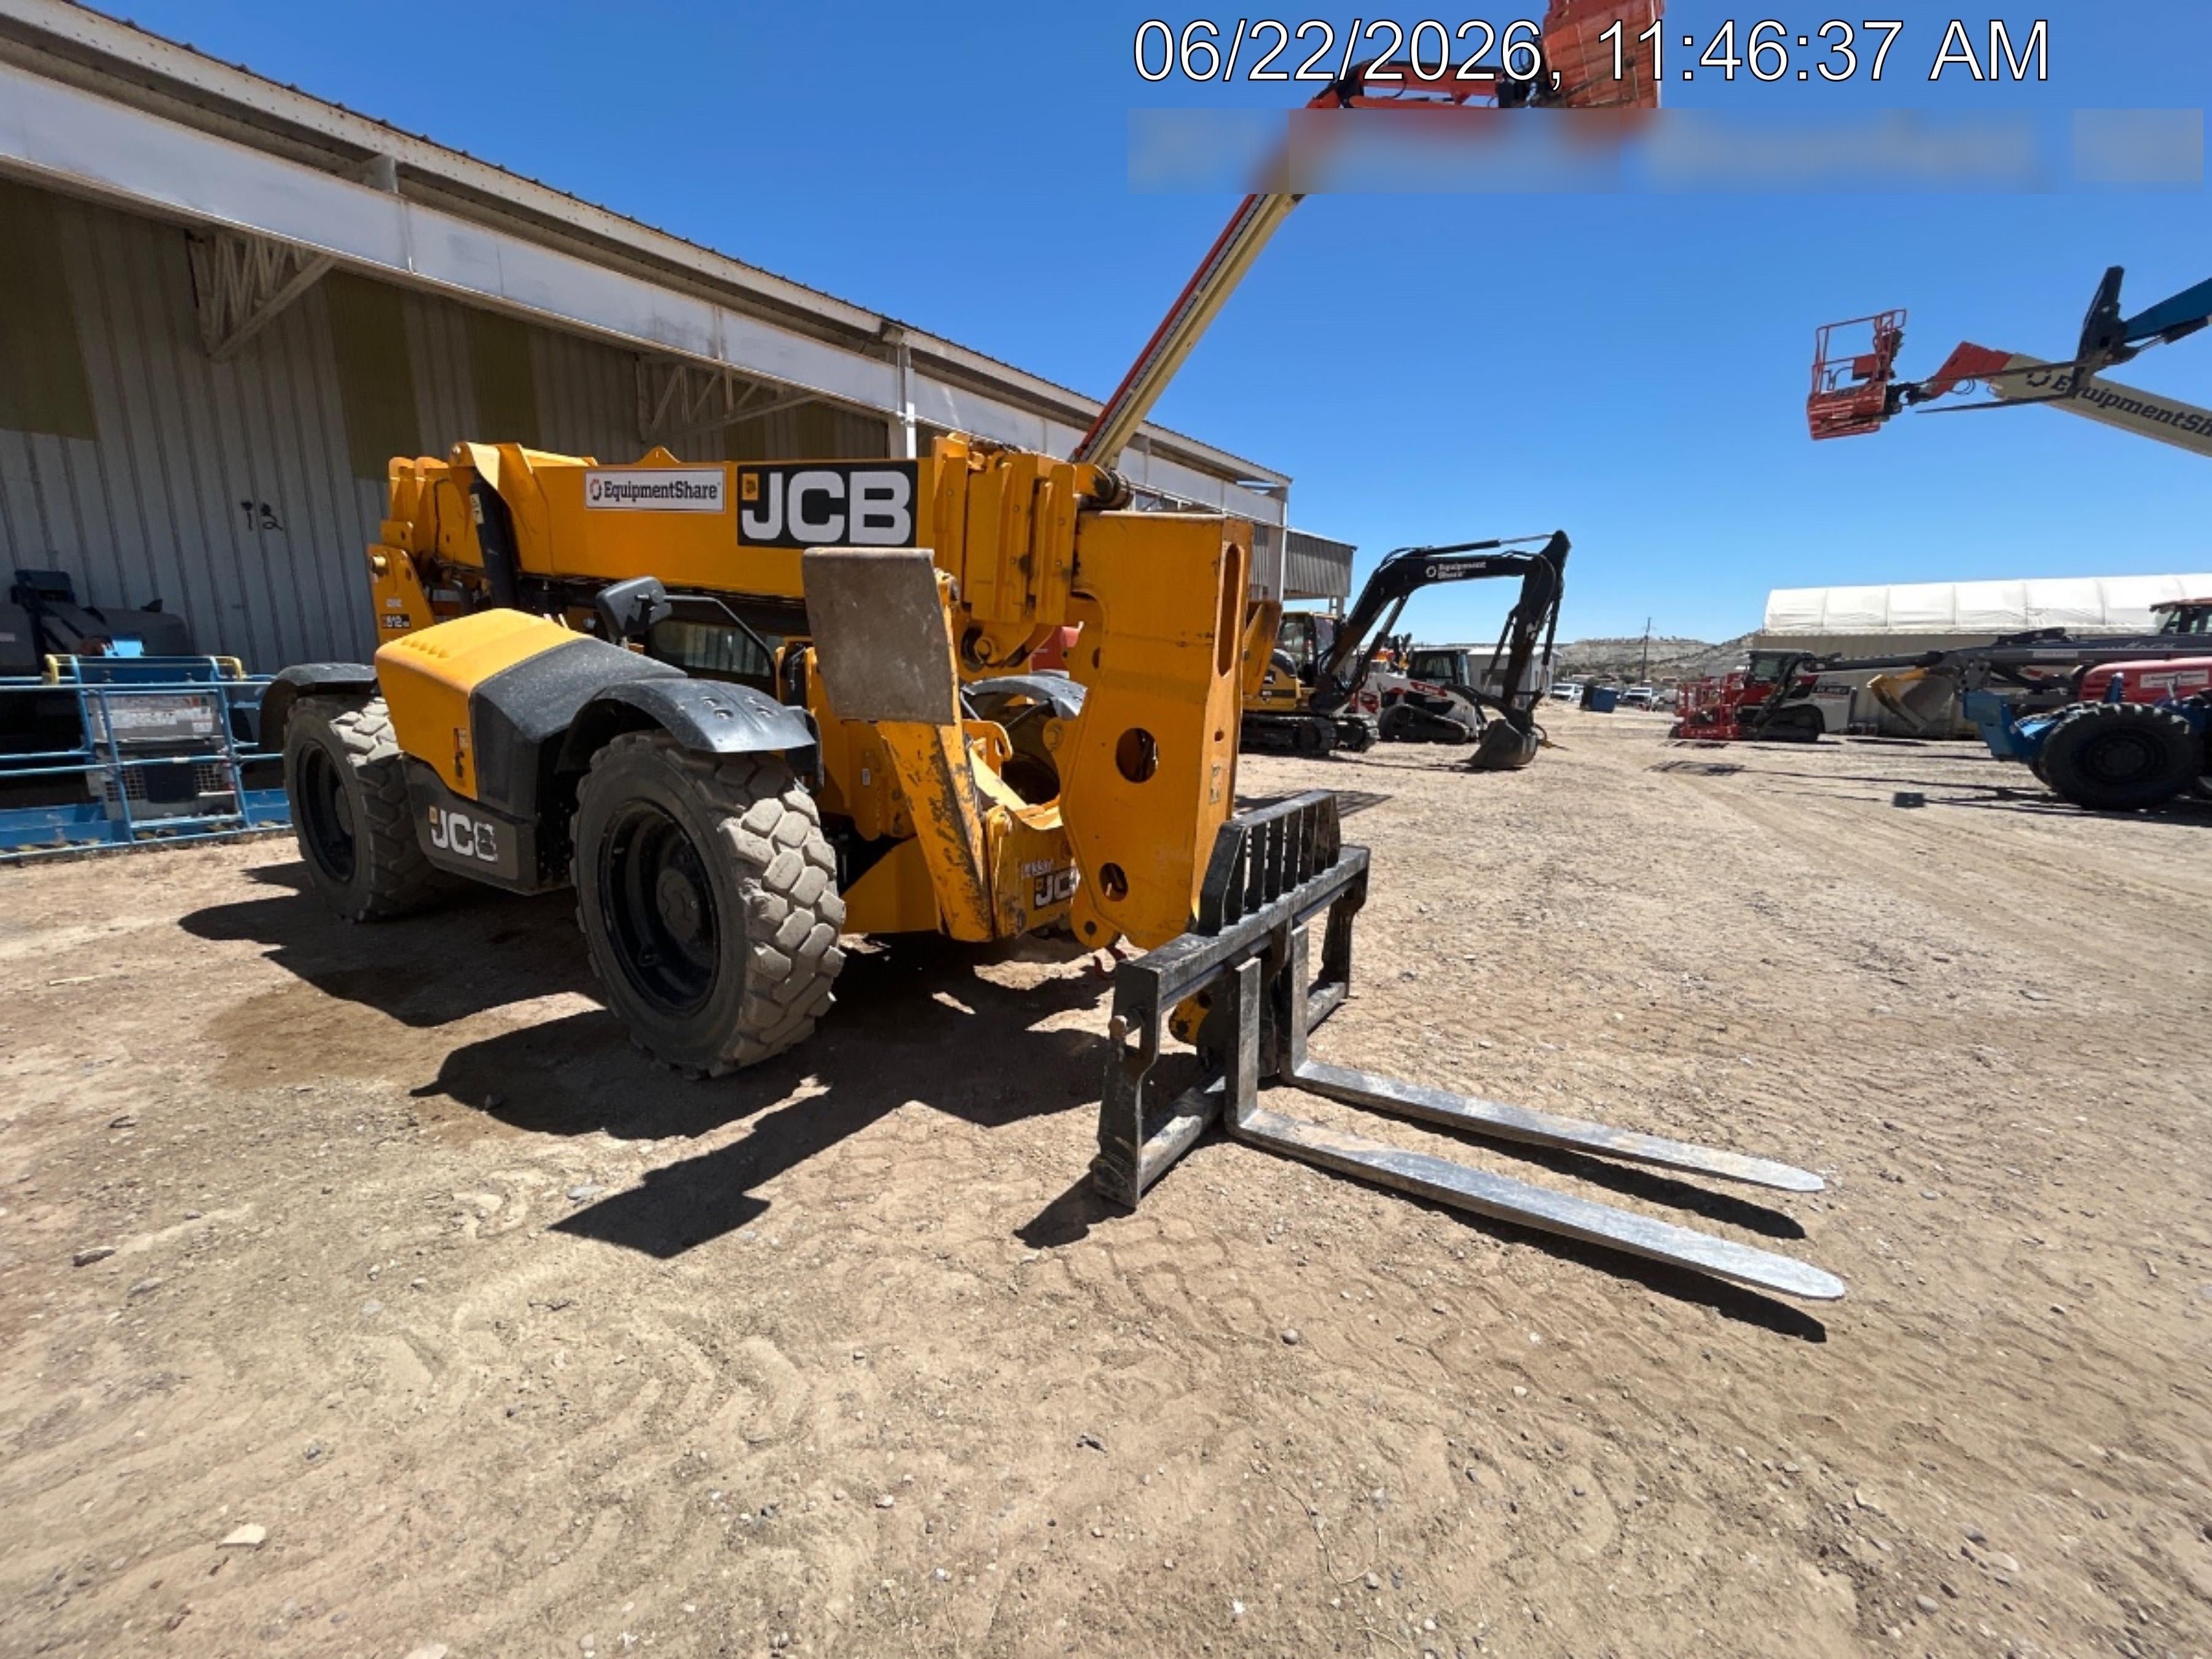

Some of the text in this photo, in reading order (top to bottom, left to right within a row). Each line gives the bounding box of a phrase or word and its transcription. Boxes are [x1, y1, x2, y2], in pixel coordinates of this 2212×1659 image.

[604, 480, 718, 502] EquipmentShare
[742, 471, 911, 544] JCB
[1035, 868, 1081, 906] JC
